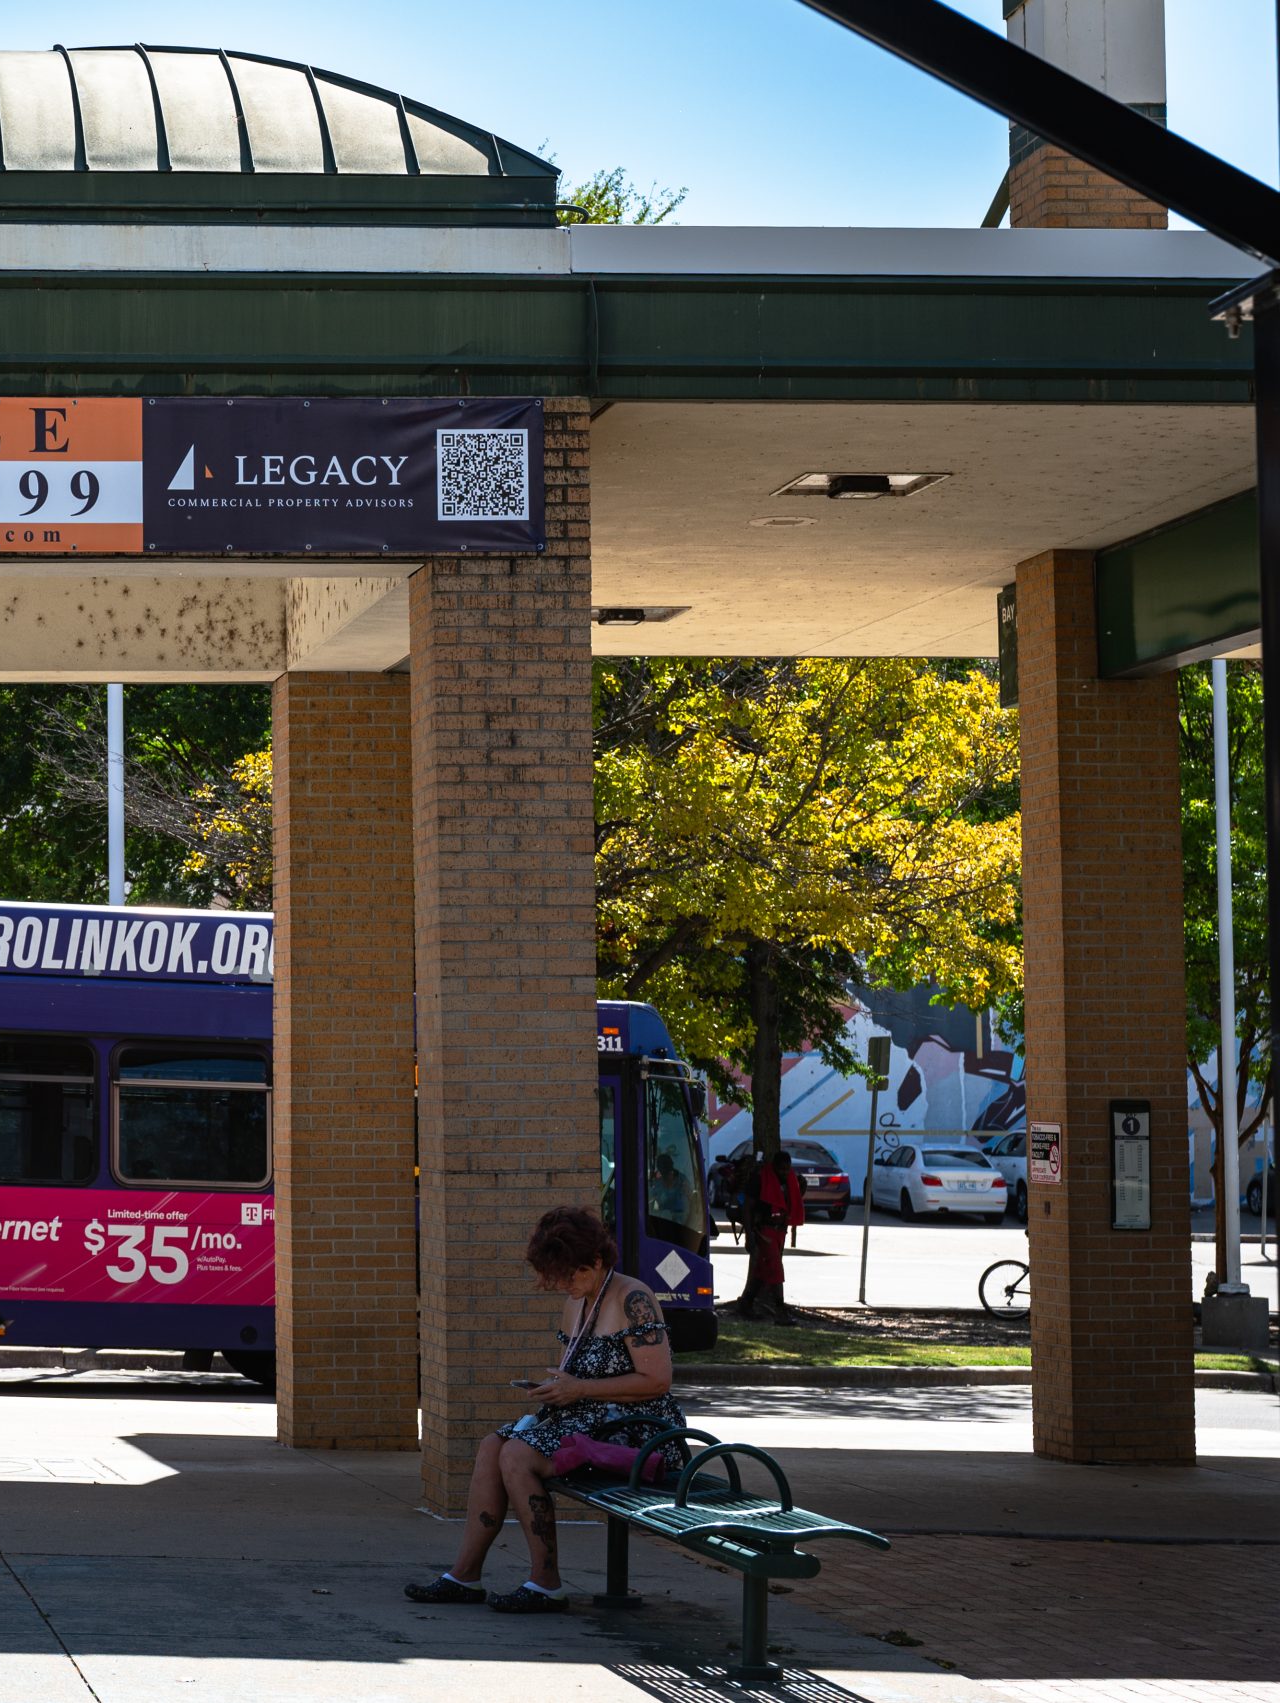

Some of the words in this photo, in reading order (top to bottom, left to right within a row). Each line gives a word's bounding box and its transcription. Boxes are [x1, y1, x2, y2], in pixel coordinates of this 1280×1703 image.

[234, 455, 409, 486] LEGACY
[167, 498, 262, 507] COMMERCIAL
[268, 498, 339, 507] PROPERTY
[345, 498, 414, 508] ADVISORS
[1001, 603, 1015, 624] BAY
[107, 1209, 165, 1220] Limited-time
[165, 1210, 188, 1221] offer
[263, 1208, 275, 1220] Fi
